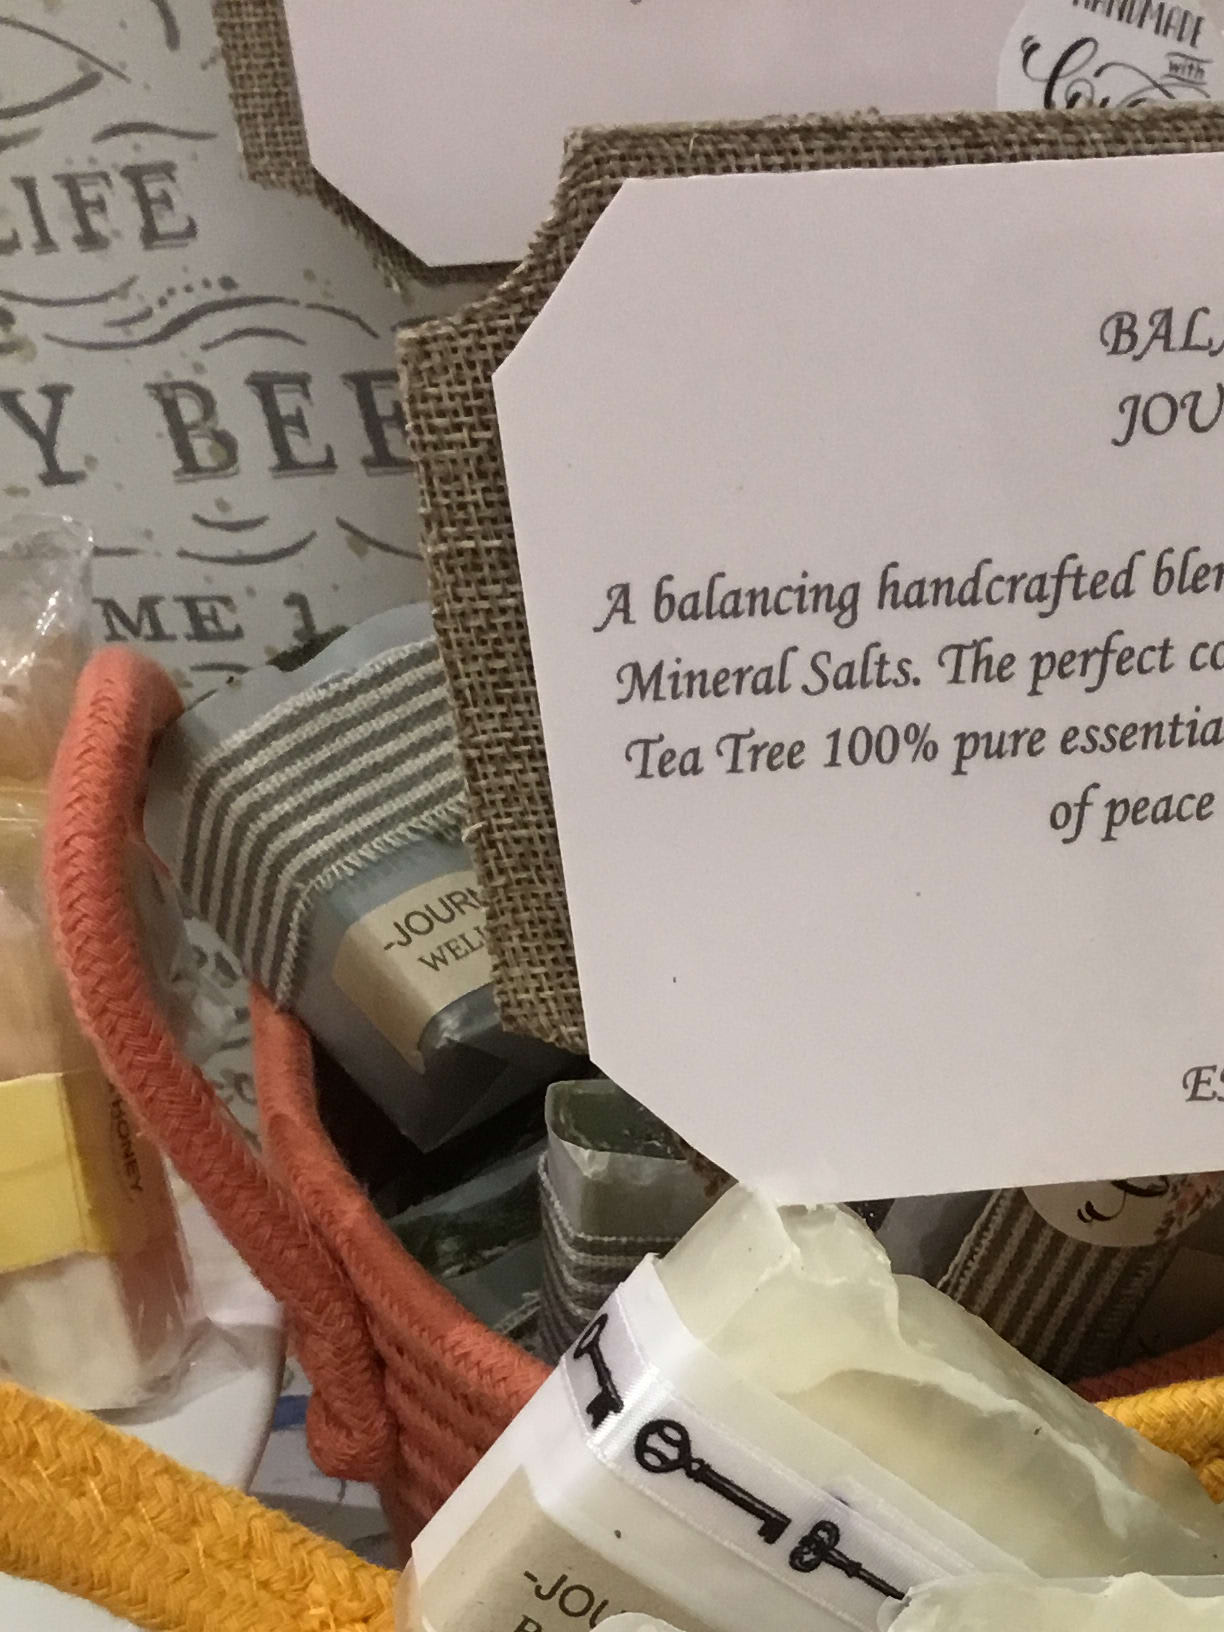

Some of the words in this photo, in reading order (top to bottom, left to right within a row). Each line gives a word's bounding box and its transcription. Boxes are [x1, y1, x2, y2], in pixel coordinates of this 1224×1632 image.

[1168, 59, 1206, 80] with
[592, 582, 636, 633] A
[654, 570, 861, 629] balancing
[877, 550, 1146, 619] handcrafted
[616, 645, 799, 705] Mineral
[801, 641, 921, 696] Salts.
[937, 636, 1016, 684] The
[1027, 629, 1175, 697] perfect
[625, 733, 704, 779] Tea
[715, 727, 806, 774] Tree
[823, 722, 939, 768] 100%
[953, 727, 1046, 775] pure
[1049, 783, 1101, 844] of
[1101, 791, 1215, 844] peace
